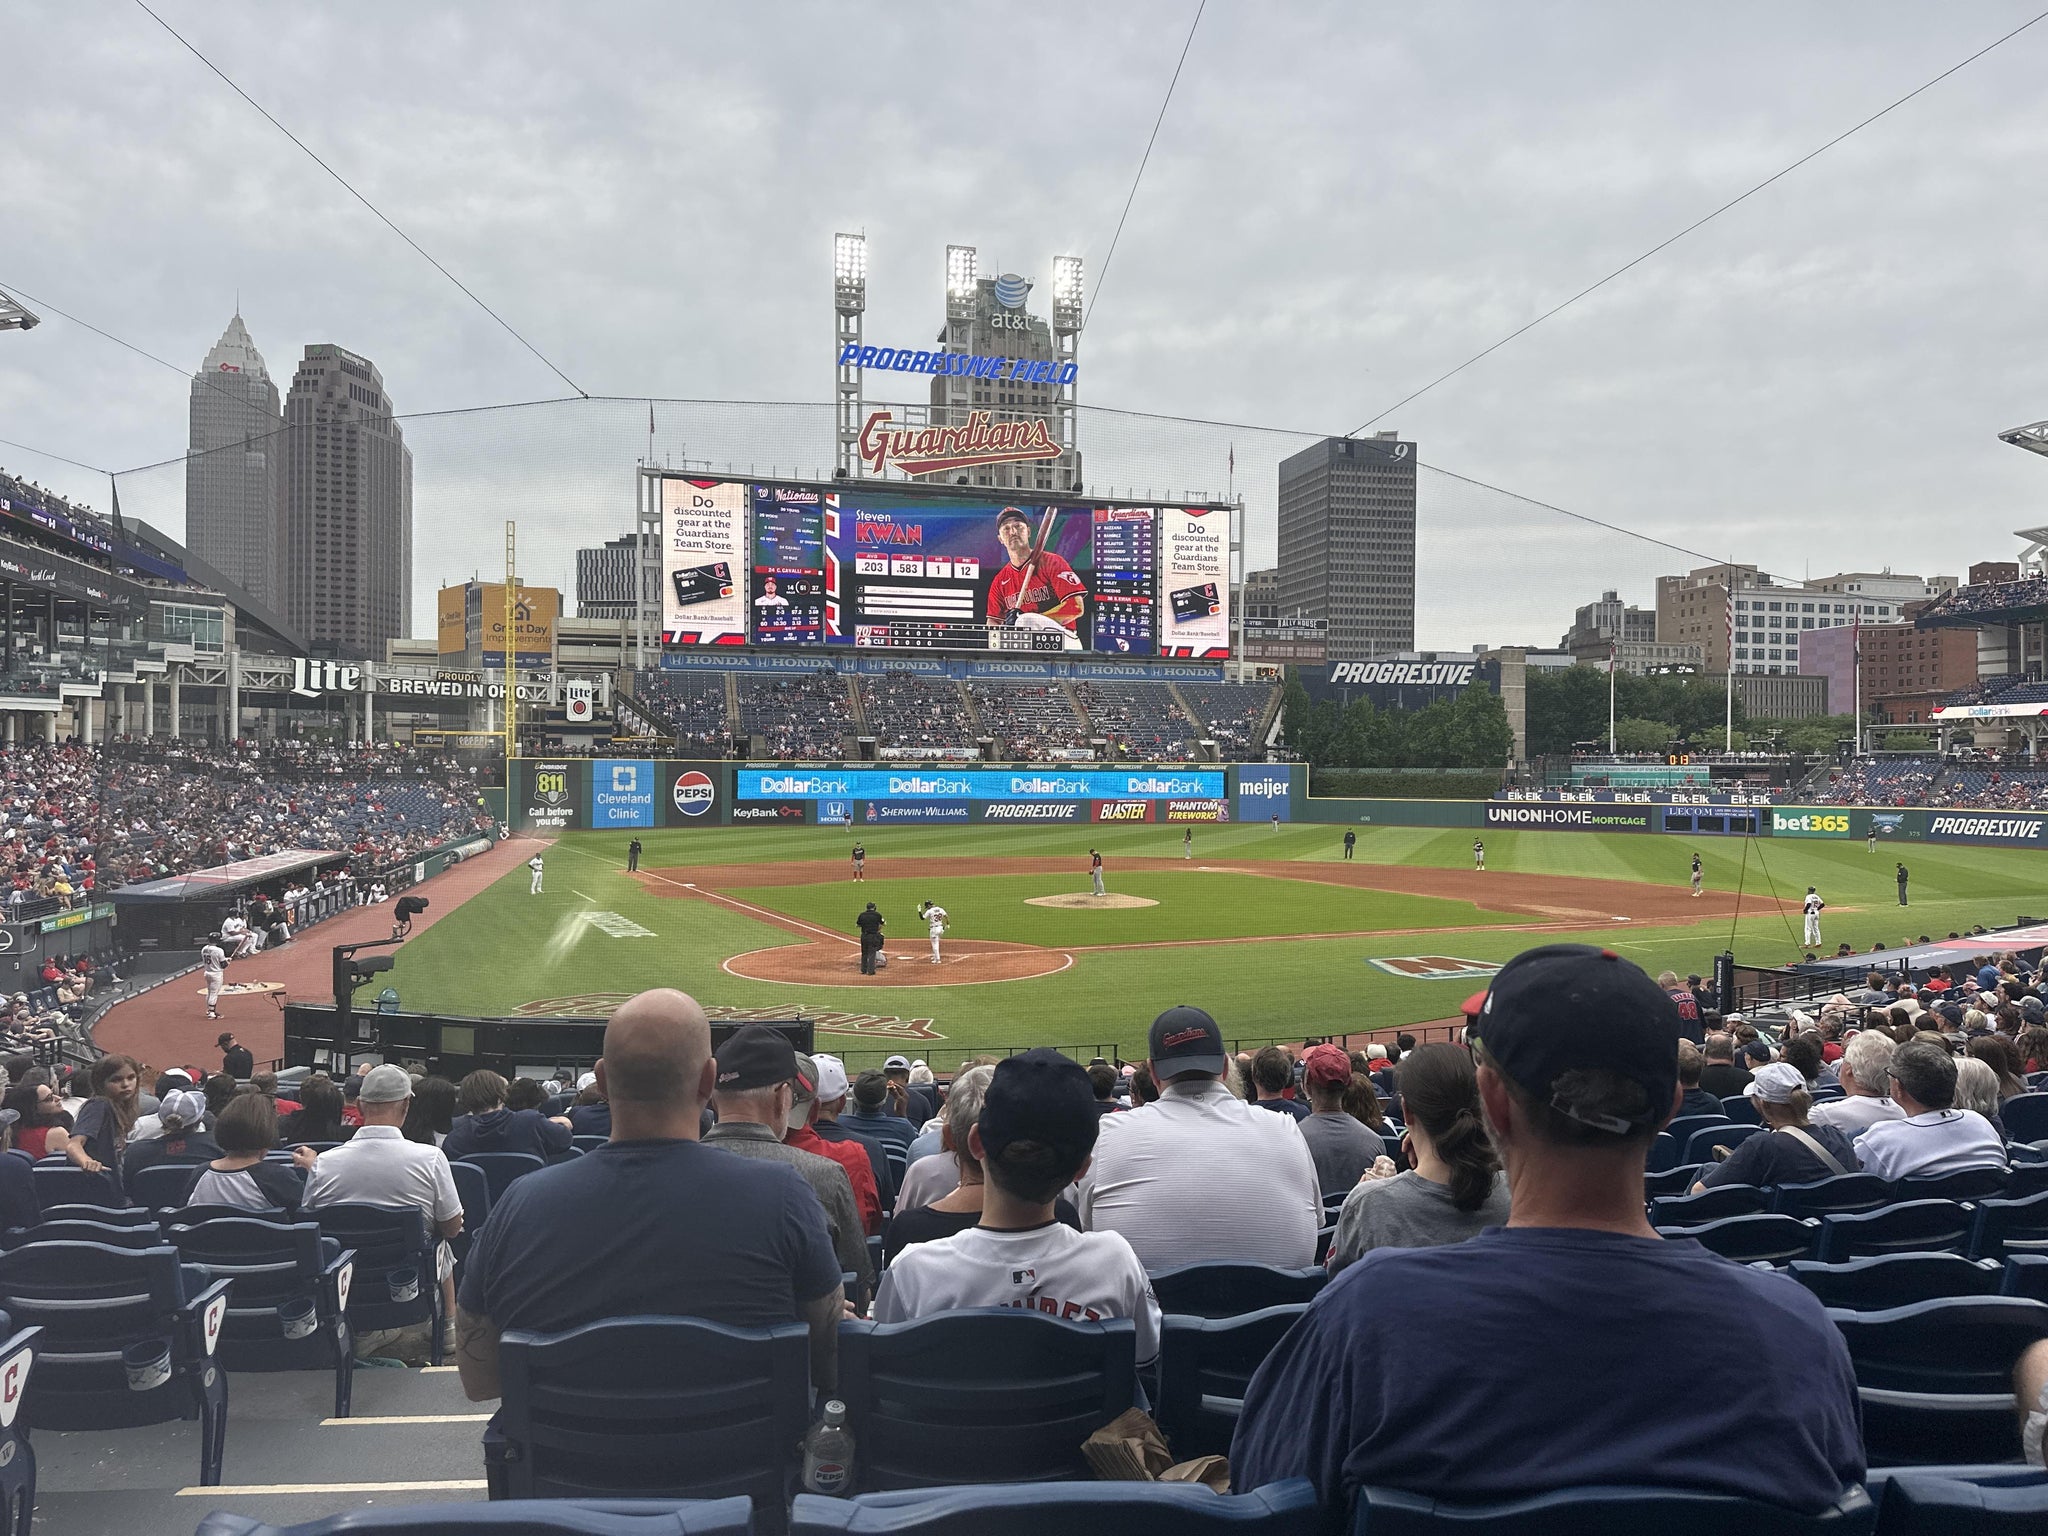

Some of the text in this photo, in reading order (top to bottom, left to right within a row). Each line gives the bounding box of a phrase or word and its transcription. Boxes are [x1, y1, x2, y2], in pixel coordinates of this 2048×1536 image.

[991, 310, 1032, 331] at&t
[838, 344, 1079, 385] PROGRESSIVE FIELD
[858, 408, 1063, 476] Guardians
[776, 489, 818, 502] Nationals
[693, 496, 714, 508] Do
[674, 507, 732, 518] discounted
[856, 510, 890, 522] Steven
[1111, 508, 1152, 522] Guardians
[677, 520, 700, 528] gear
[714, 520, 730, 528] the
[1188, 523, 1205, 534] Do
[676, 528, 730, 539] Guardians
[856, 522, 922, 546] KWAN
[1172, 534, 1220, 542] discounted
[674, 539, 703, 548] Team
[1174, 554, 1218, 562] Guardians
[714, 564, 725, 578] C
[862, 562, 970, 576] .203 .583 1 12
[1172, 563, 1195, 571] Team
[1204, 584, 1214, 597] C
[1278, 619, 1317, 628] RALLY HOUSE
[526, 624, 548, 636] Day
[685, 656, 751, 666] HONDA
[771, 657, 834, 668] HONDA
[881, 660, 941, 671] HONDA
[989, 664, 1046, 673] HONDA
[1091, 666, 1146, 675] HONDA
[1164, 667, 1218, 677] HONDA
[1330, 662, 1475, 685] PROGRESSIVE
[289, 656, 360, 698] Lite
[438, 672, 482, 682] PROUDLY
[389, 678, 463, 697] BREWED
[467, 684, 484, 697] IN
[569, 688, 590, 700] Lite
[1968, 707, 2010, 716] DollarBank
[1670, 755, 1689, 765] 0:13
[538, 774, 564, 792] 811
[761, 777, 848, 794] DollarBank
[890, 777, 972, 794] DollarBank
[1011, 778, 1090, 794] DollarBank
[1128, 778, 1204, 794] DollarBank
[1240, 778, 1289, 799] meijer
[598, 793, 651, 804] Cleveland
[676, 788, 712, 798] PEPSI
[529, 808, 574, 816] Call before
[985, 804, 1076, 818] PROGRESSIVE
[1100, 803, 1146, 820] BLASTER
[1170, 802, 1218, 810] PHANTOM
[609, 808, 640, 819] Clinic
[734, 808, 778, 818] KeyBank
[536, 817, 566, 827] you dig.
[820, 817, 846, 825] HOND
[1592, 816, 1646, 825] MORTGAGE
[1773, 814, 1849, 832] bet365
[1930, 817, 2043, 838] PROGRESSIVE
[1678, 1001, 1698, 1020] 48
[1162, 1027, 1208, 1051] Guardians
[342, 1270, 347, 1296] C
[209, 1306, 218, 1336] C
[4, 1362, 18, 1403] C
[816, 1471, 844, 1480] PEPSI
